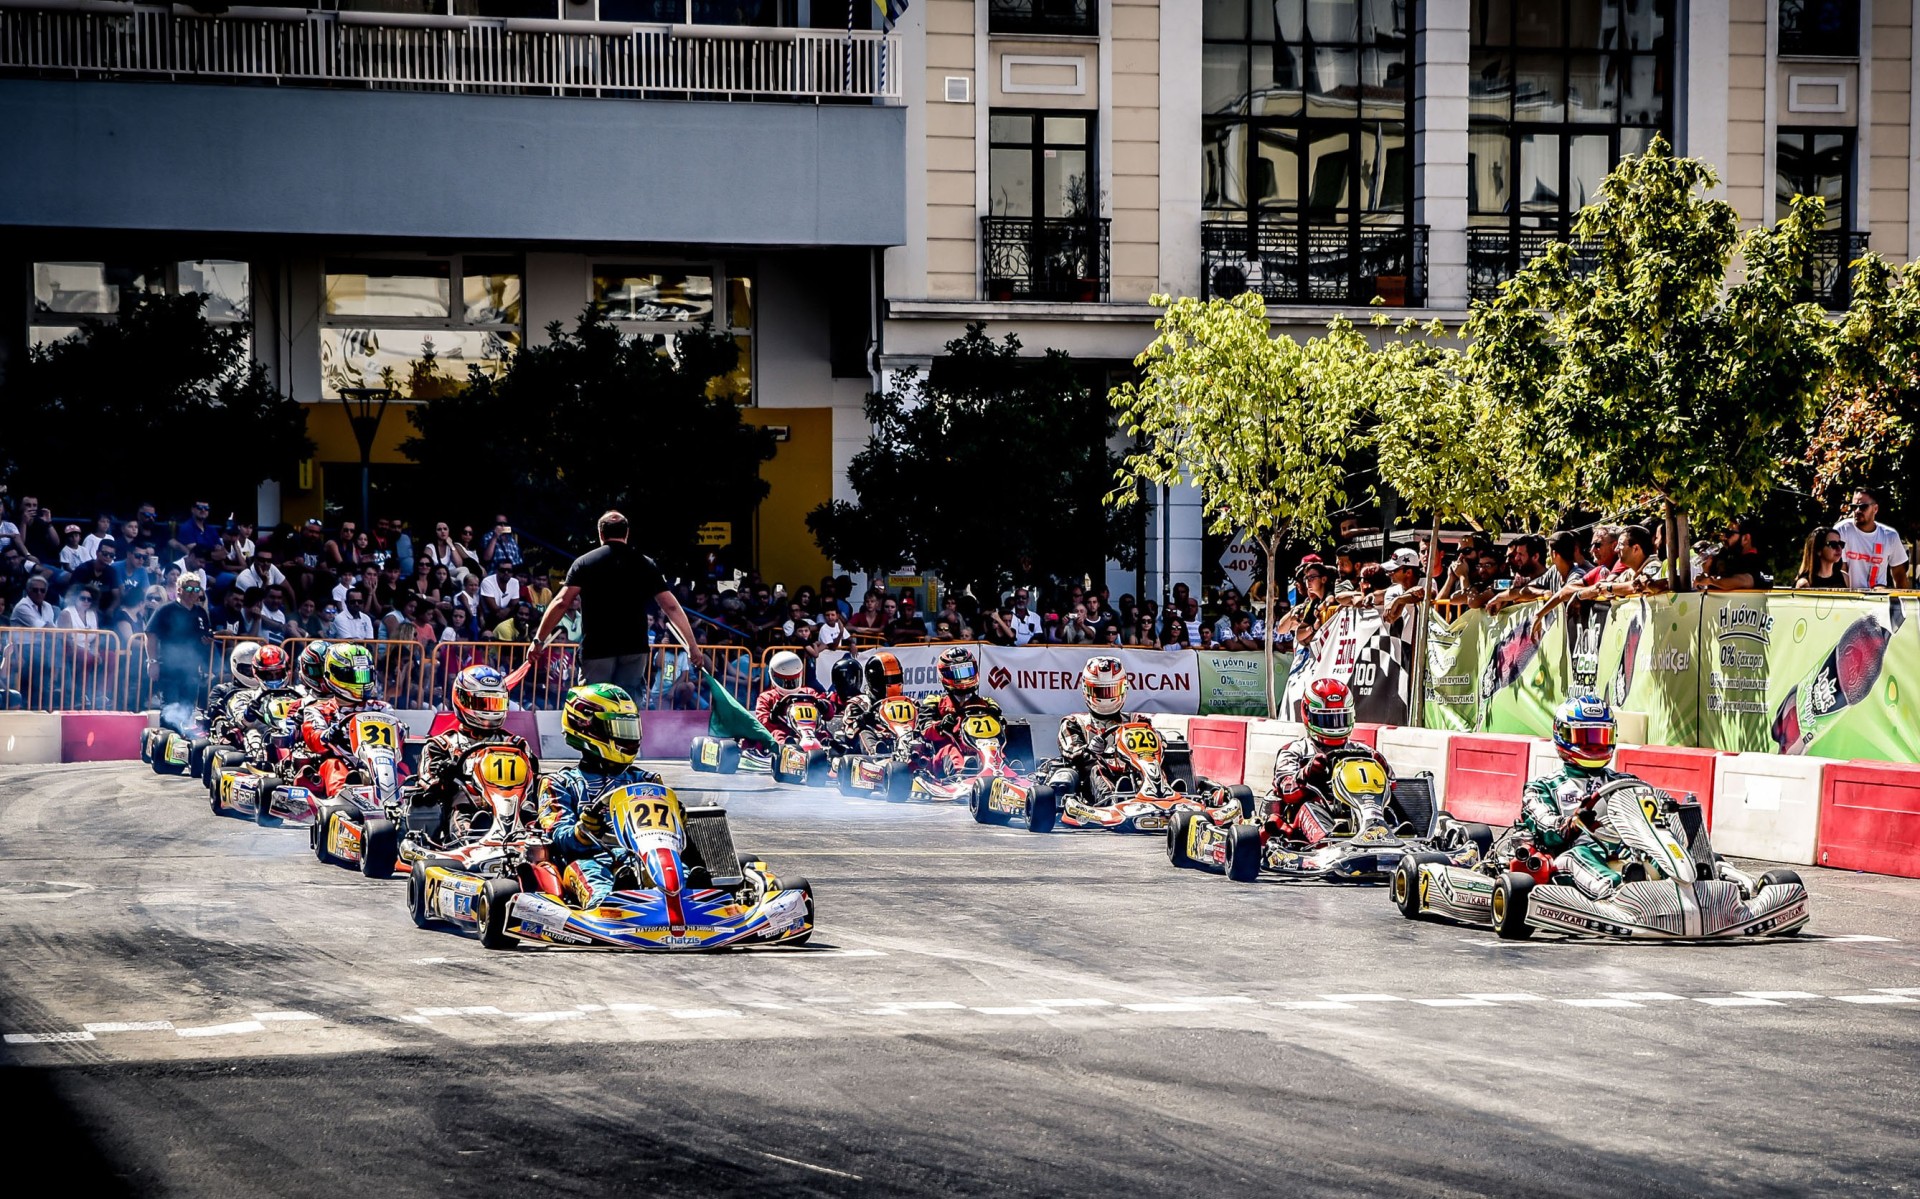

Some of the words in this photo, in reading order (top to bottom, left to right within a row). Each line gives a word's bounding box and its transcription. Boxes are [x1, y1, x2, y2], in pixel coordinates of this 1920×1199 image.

[1731, 602, 1757, 630] μόνη
[1759, 613, 1774, 634] με
[1222, 656, 1244, 668] μόνη
[1247, 660, 1258, 669] με
[1721, 645, 1735, 666] 0%
[1736, 651, 1763, 669] ζάχαρη
[1017, 670, 1190, 691] INTERARICAN
[1221, 675, 1234, 685] 0%
[1353, 662, 1377, 686] 100
[1359, 687, 1373, 696] RON
[798, 707, 812, 719] 10
[889, 704, 911, 720] 171
[1585, 707, 1603, 715] Arai
[364, 725, 391, 746] 31
[973, 720, 992, 734] 21
[1125, 729, 1158, 750] 629
[493, 758, 517, 781] 17
[1359, 767, 1368, 783] 1
[223, 779, 232, 805] 31
[634, 803, 670, 829] 27
[1421, 873, 1430, 908] 2
[1538, 907, 1559, 919] TONY
[665, 935, 700, 945] Chatzis
